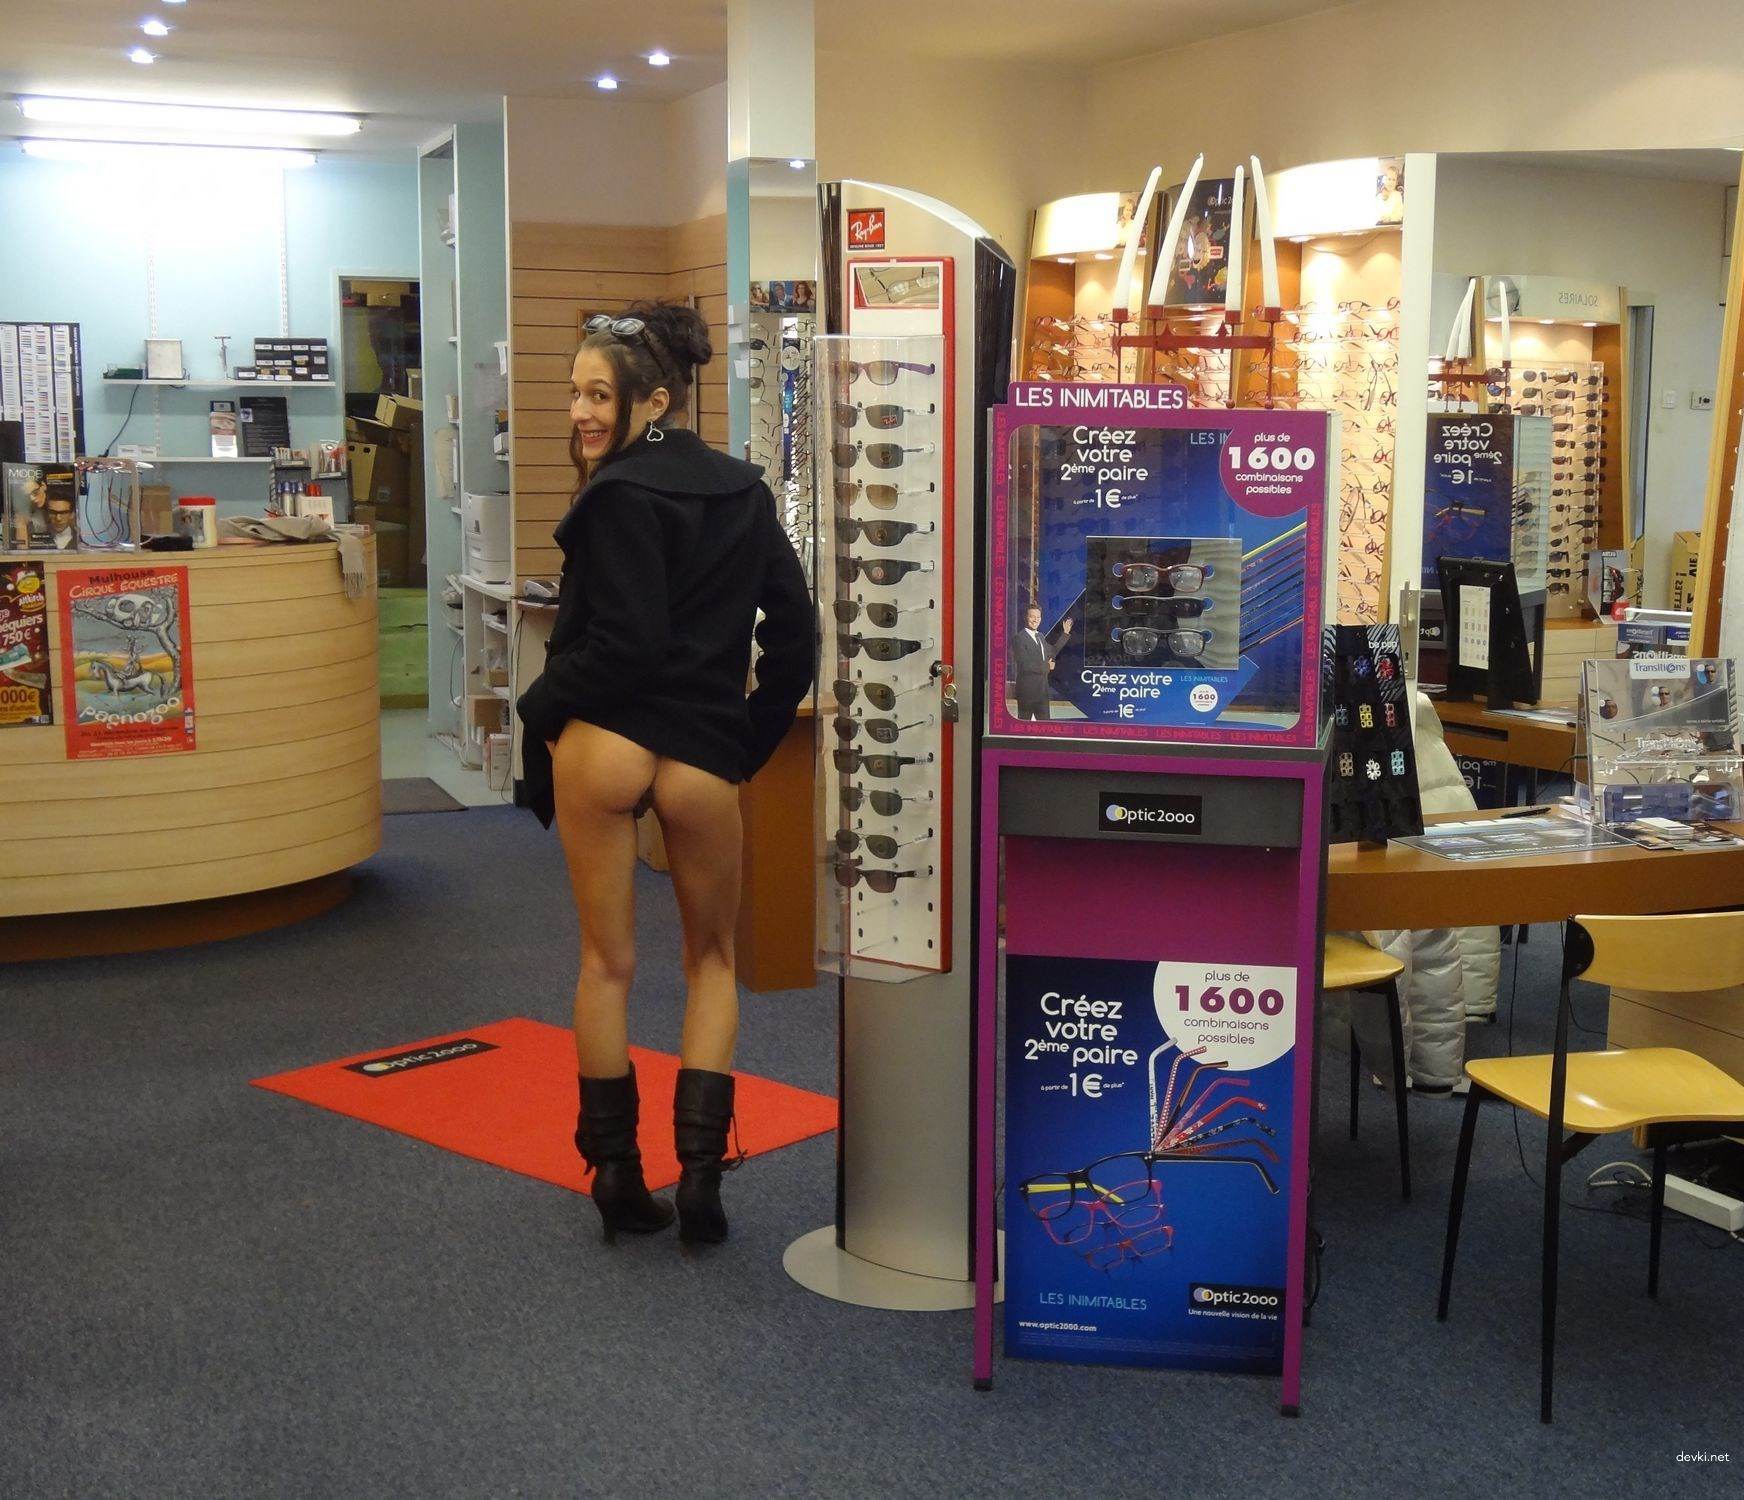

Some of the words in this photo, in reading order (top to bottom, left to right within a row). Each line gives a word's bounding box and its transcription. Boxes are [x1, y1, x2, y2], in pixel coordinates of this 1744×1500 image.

[1016, 387, 1053, 407] LES
[1060, 389, 1183, 409] INIMITABLES
[1072, 425, 1136, 445] Créez
[1190, 432, 1215, 445] LES
[1254, 432, 1275, 444] plus
[1277, 432, 1291, 443] de
[1076, 446, 1132, 463] votre
[1098, 465, 1148, 485] paire
[1235, 472, 1303, 483] combinaisons
[1246, 484, 1292, 495] possibles
[0, 614, 43, 632] équiers
[1634, 662, 1686, 673] Transitions
[1081, 670, 1127, 684] Créez
[1131, 674, 1172, 685] votre
[1120, 686, 1161, 700] paire
[1205, 970, 1231, 983] plus
[1234, 971, 1250, 982] de
[1040, 991, 1123, 1019] Créez
[1045, 1018, 1118, 1042] votre
[1184, 1017, 1269, 1031] combinaisons
[1197, 1033, 1255, 1045] possibles
[1024, 1039, 1069, 1061] 2ème
[1073, 1045, 1138, 1068] paire
[1040, 1292, 1064, 1305] LES
[1068, 1294, 1147, 1311] INIMITABLES
[1203, 1310, 1230, 1318] nouvelle
[1019, 1320, 1097, 1332] www.optic2000.com
